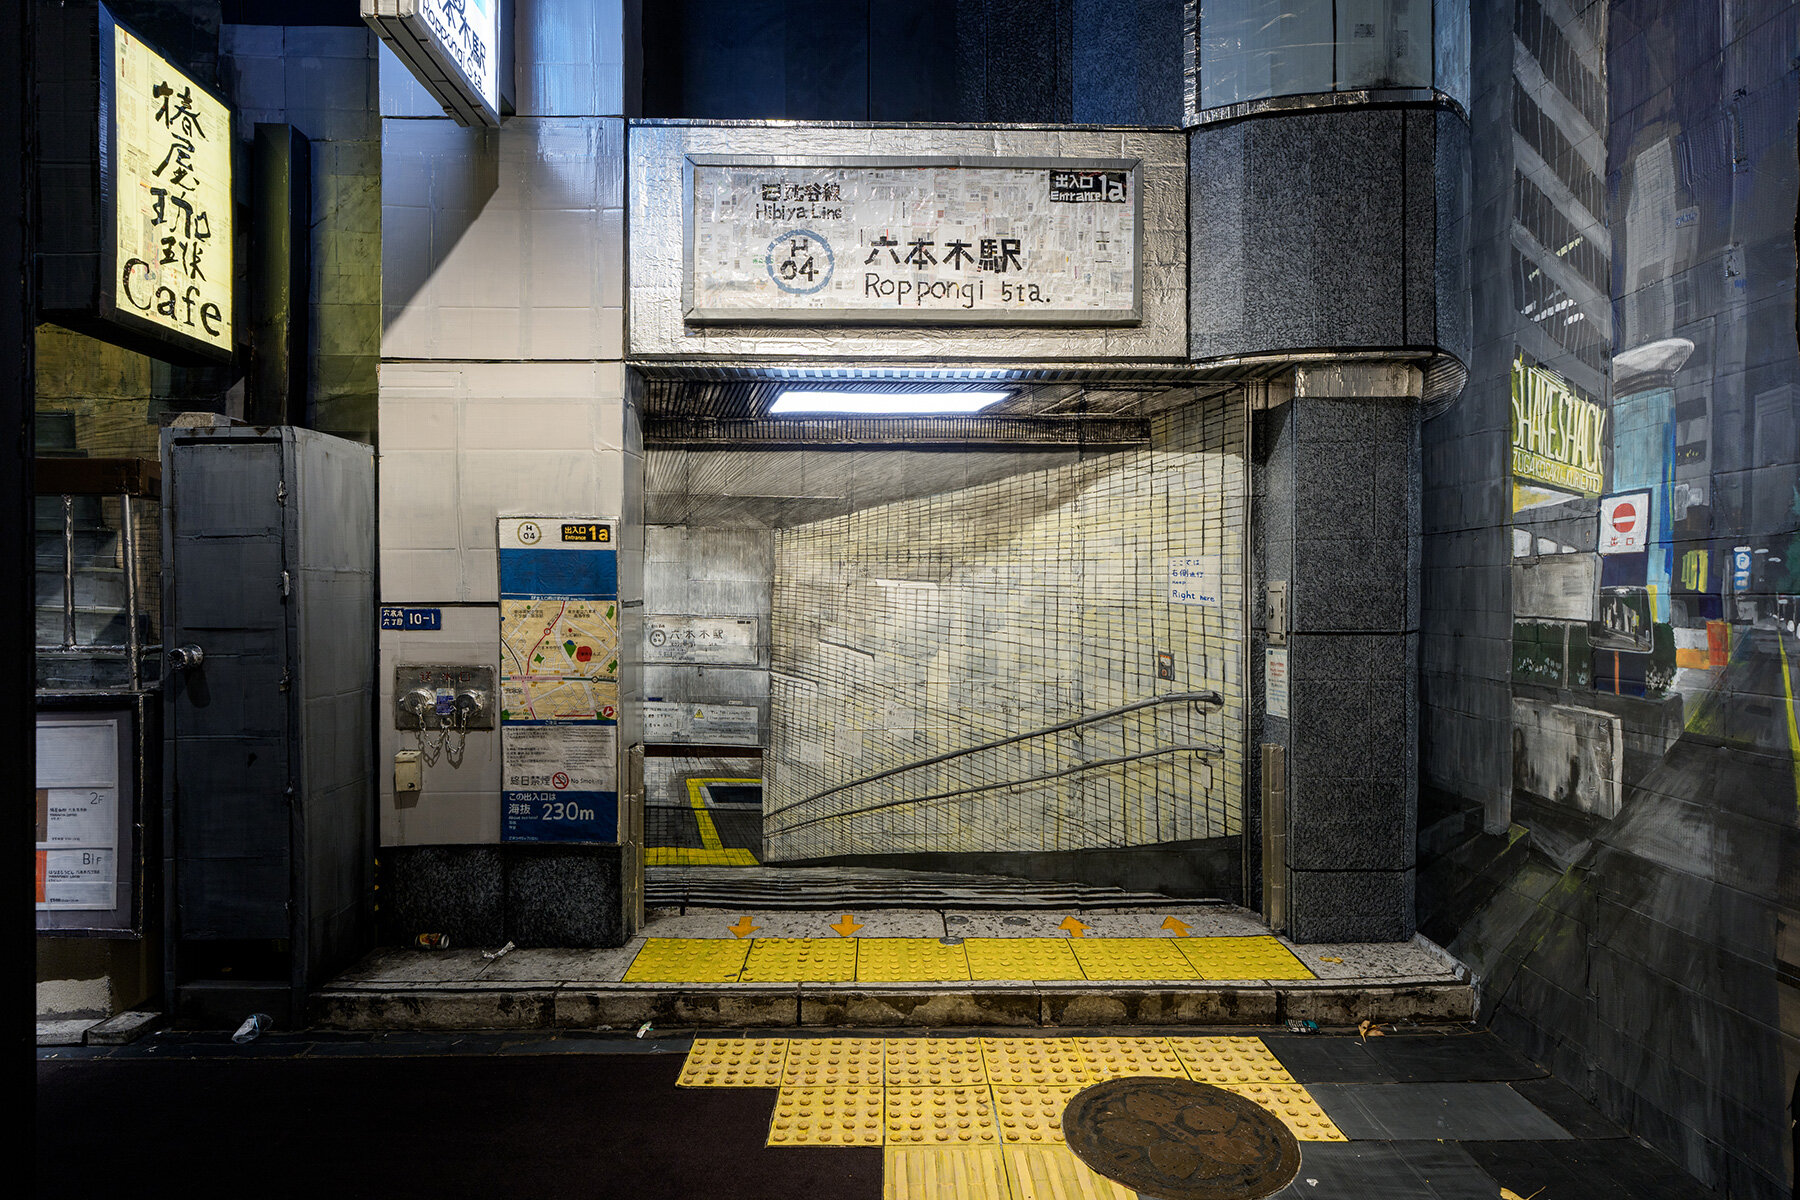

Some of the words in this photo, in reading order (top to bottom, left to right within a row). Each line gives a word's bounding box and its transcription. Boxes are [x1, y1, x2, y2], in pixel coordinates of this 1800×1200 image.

[438, 0, 487, 76] 本木駅
[152, 81, 211, 283] 椿屋珈琲
[1055, 174, 1093, 189] 出入口
[1098, 174, 1126, 202] 1a
[1051, 190, 1101, 202] Entrance
[756, 203, 807, 221] Hibiya
[812, 202, 842, 219] Line
[791, 239, 808, 258] H
[864, 236, 1022, 273] 六本木駅
[780, 257, 819, 282] 04
[122, 257, 222, 337] Cafe
[865, 273, 984, 308] Roppongi
[565, 526, 586, 534] 出入口
[589, 525, 609, 541] 1a
[1172, 589, 1195, 601] Right
[409, 613, 435, 625] 10-1
[89, 792, 105, 805] 2F
[508, 793, 557, 802] この出入口は
[508, 803, 531, 815] 海抜
